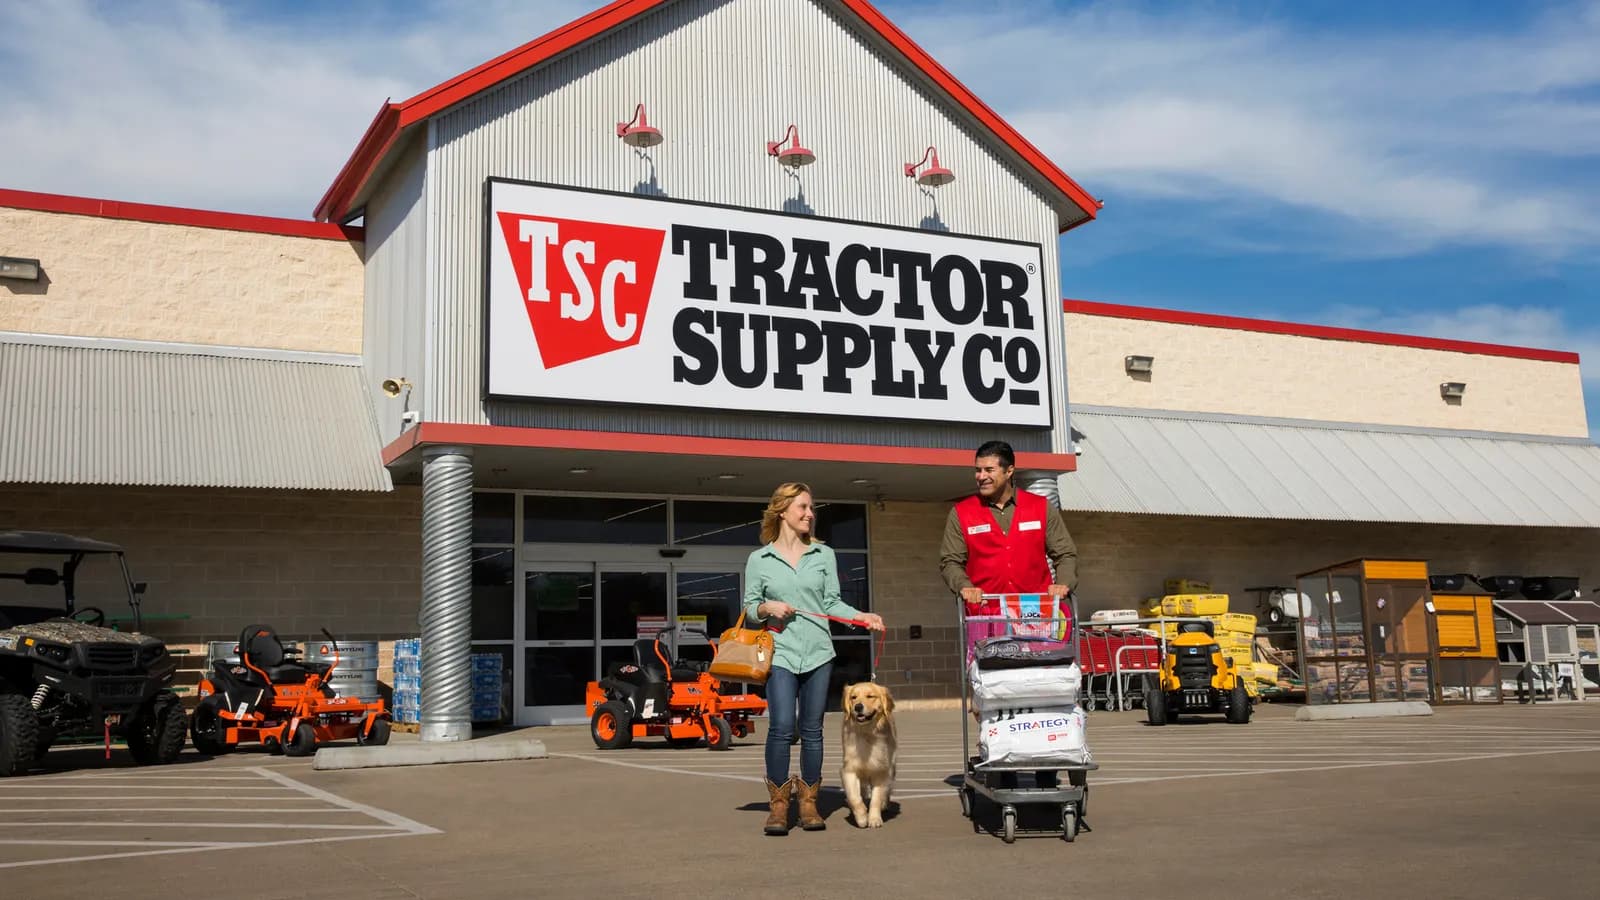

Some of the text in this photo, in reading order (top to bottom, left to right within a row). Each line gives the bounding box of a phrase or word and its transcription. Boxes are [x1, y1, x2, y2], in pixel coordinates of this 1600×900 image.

[518, 218, 638, 343] TSC
[671, 223, 1035, 331] TRACTOR
[672, 306, 955, 401] SUPPLY
[1009, 718, 1070, 732] STRATEGY
